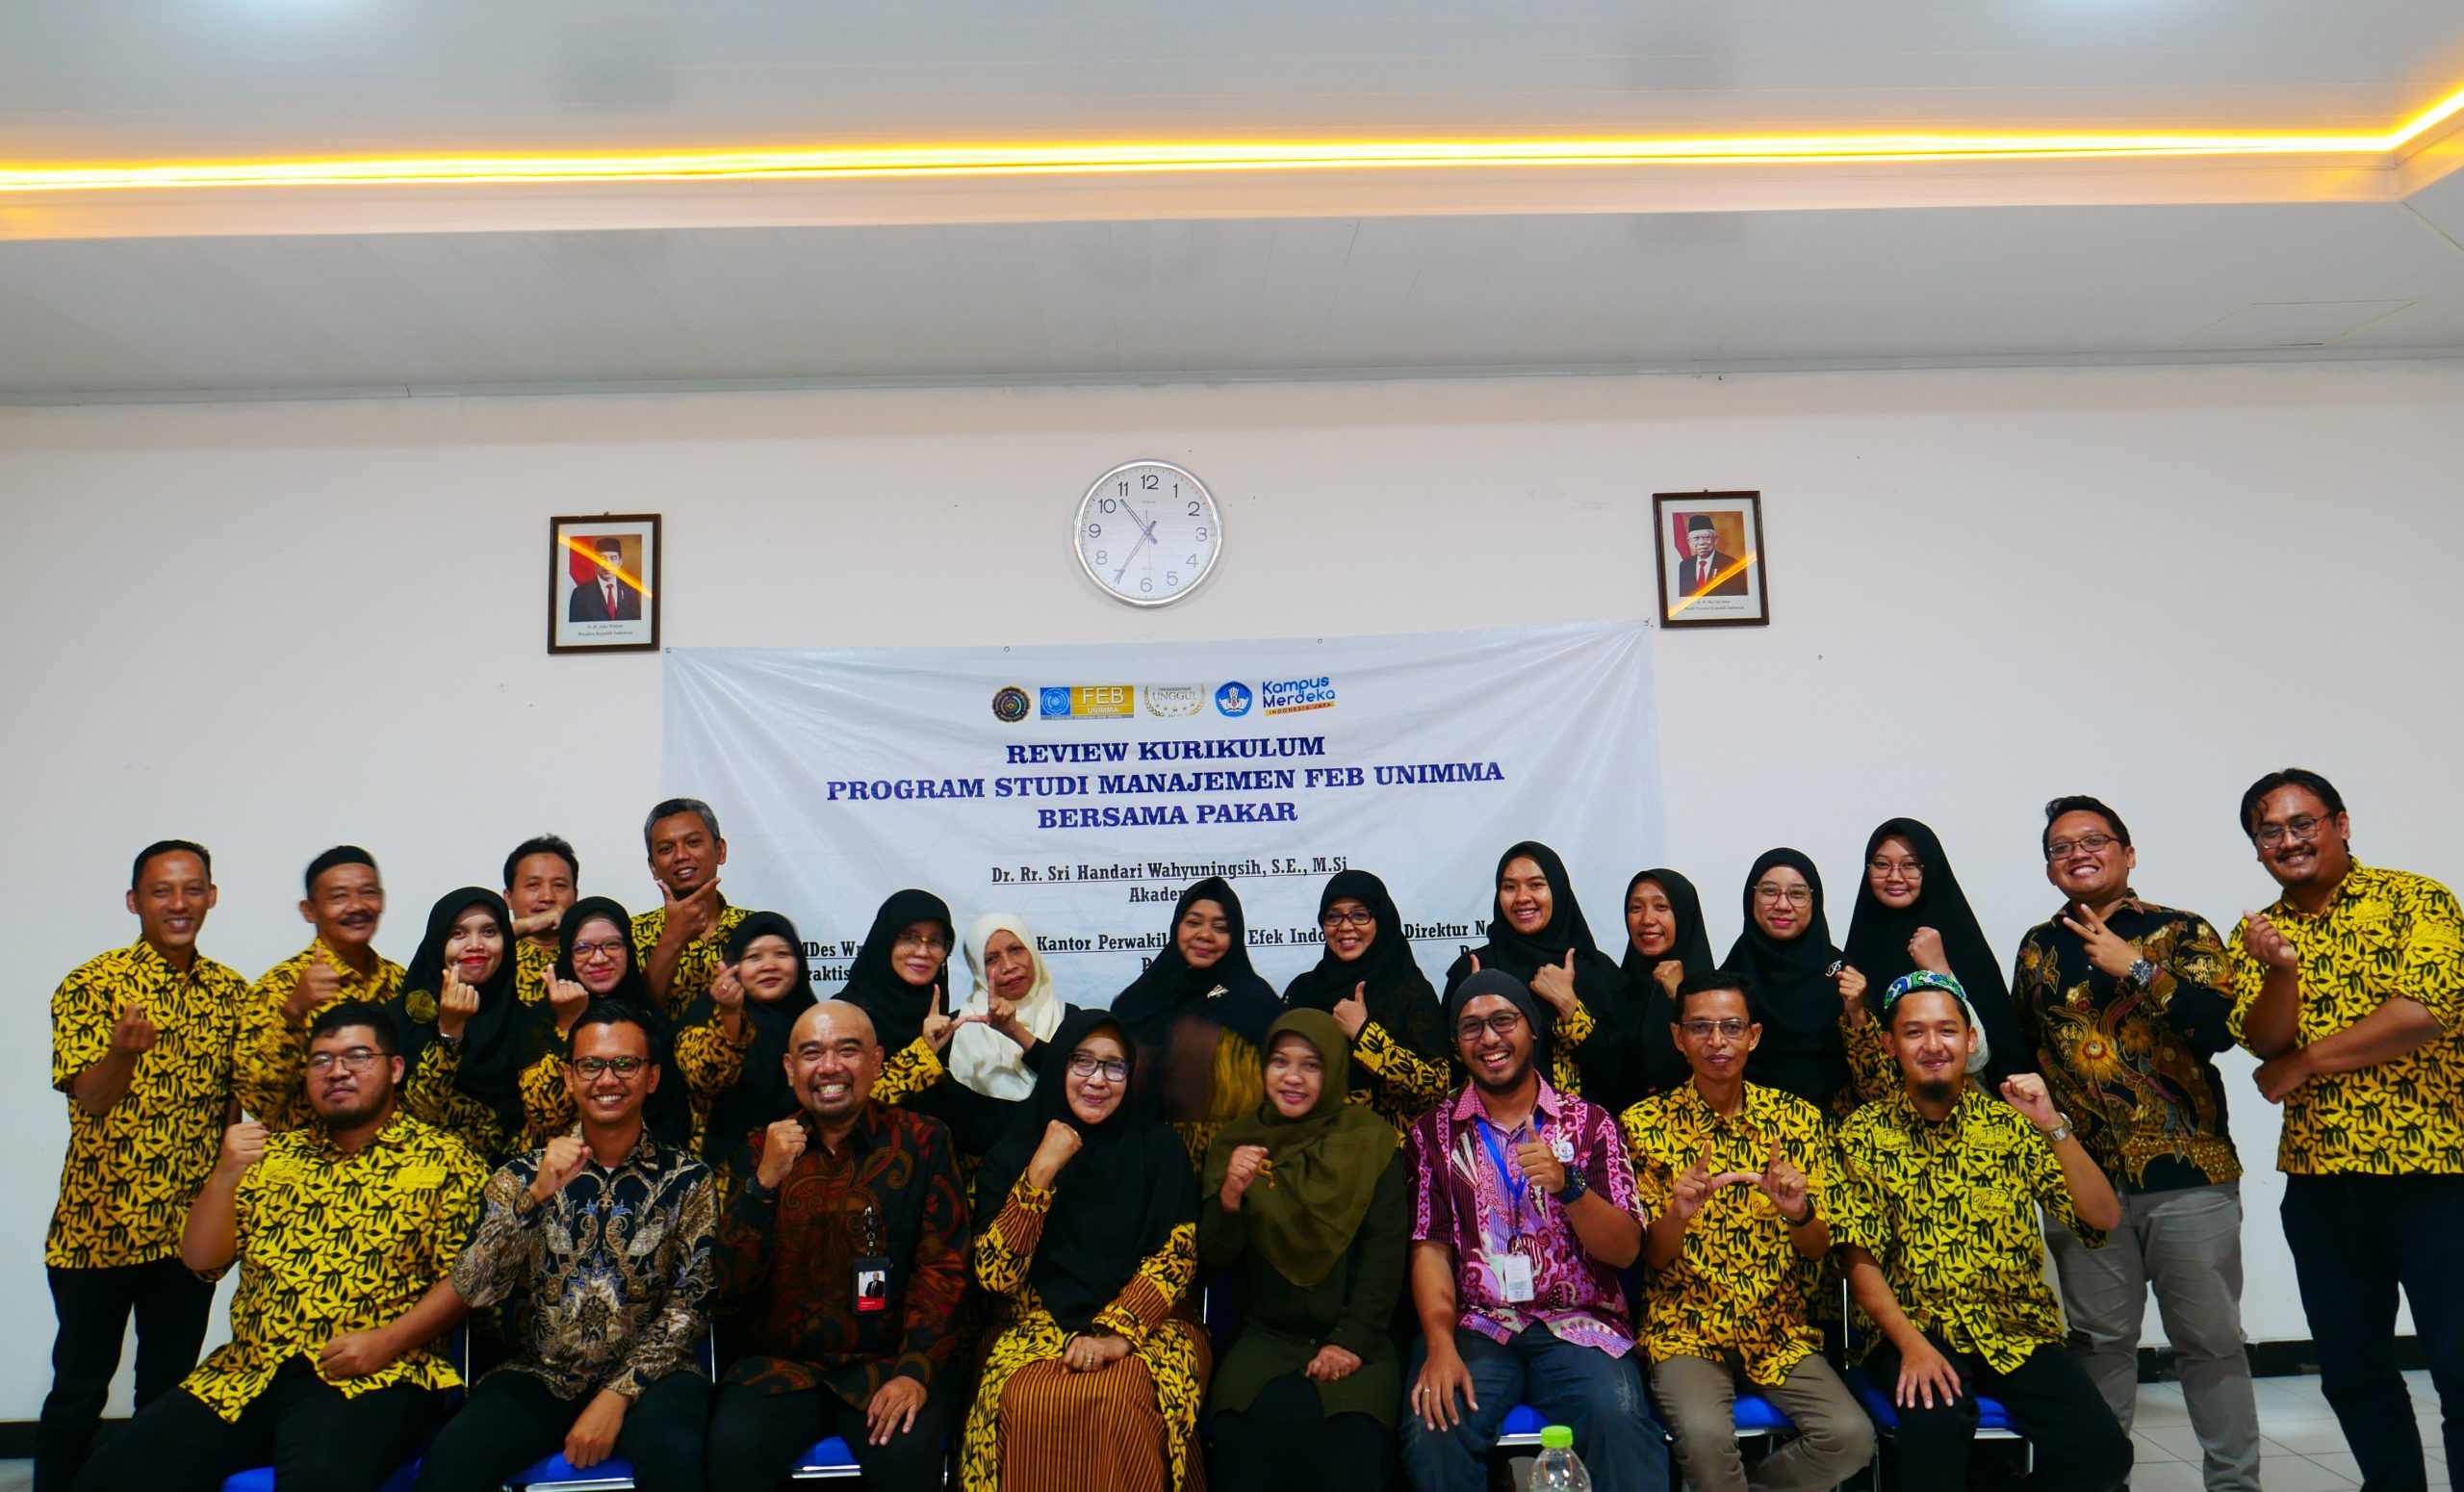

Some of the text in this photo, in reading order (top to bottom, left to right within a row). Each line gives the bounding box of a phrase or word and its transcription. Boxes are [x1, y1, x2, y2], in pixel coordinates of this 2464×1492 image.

[1117, 481, 1129, 497] 11
[1141, 475, 1159, 490] 12
[1172, 483, 1178, 498] 1
[1098, 498, 1116, 514] 10
[1187, 501, 1200, 516] 2
[1089, 523, 1102, 538] 9
[1195, 527, 1207, 541] 3
[1095, 550, 1107, 565] 8
[1185, 553, 1199, 568] 4
[1114, 569, 1125, 582] 7
[1167, 571, 1179, 586] 5
[1140, 578, 1152, 592] 6
[1262, 676, 1329, 695] Kampus
[1083, 687, 1125, 705] FEB
[1263, 688, 1335, 708] Merdeka
[1269, 705, 1310, 714] INDONESIA
[1007, 736, 1325, 764] REVIEW KURIKULUM
[827, 762, 1504, 800] PROGRAM STUDI MANAJEMEN FEB UNIMMA
[1038, 802, 1297, 829] BERSAMA PAKAR
[992, 856, 1348, 882] Dr. Rr. Sri Handari Wahyuningsih, S.E., M.Si
[1248, 928, 1283, 945] Efek
[1404, 923, 1468, 939] Direktur
[1037, 932, 1169, 952] Kantor Perwakil
